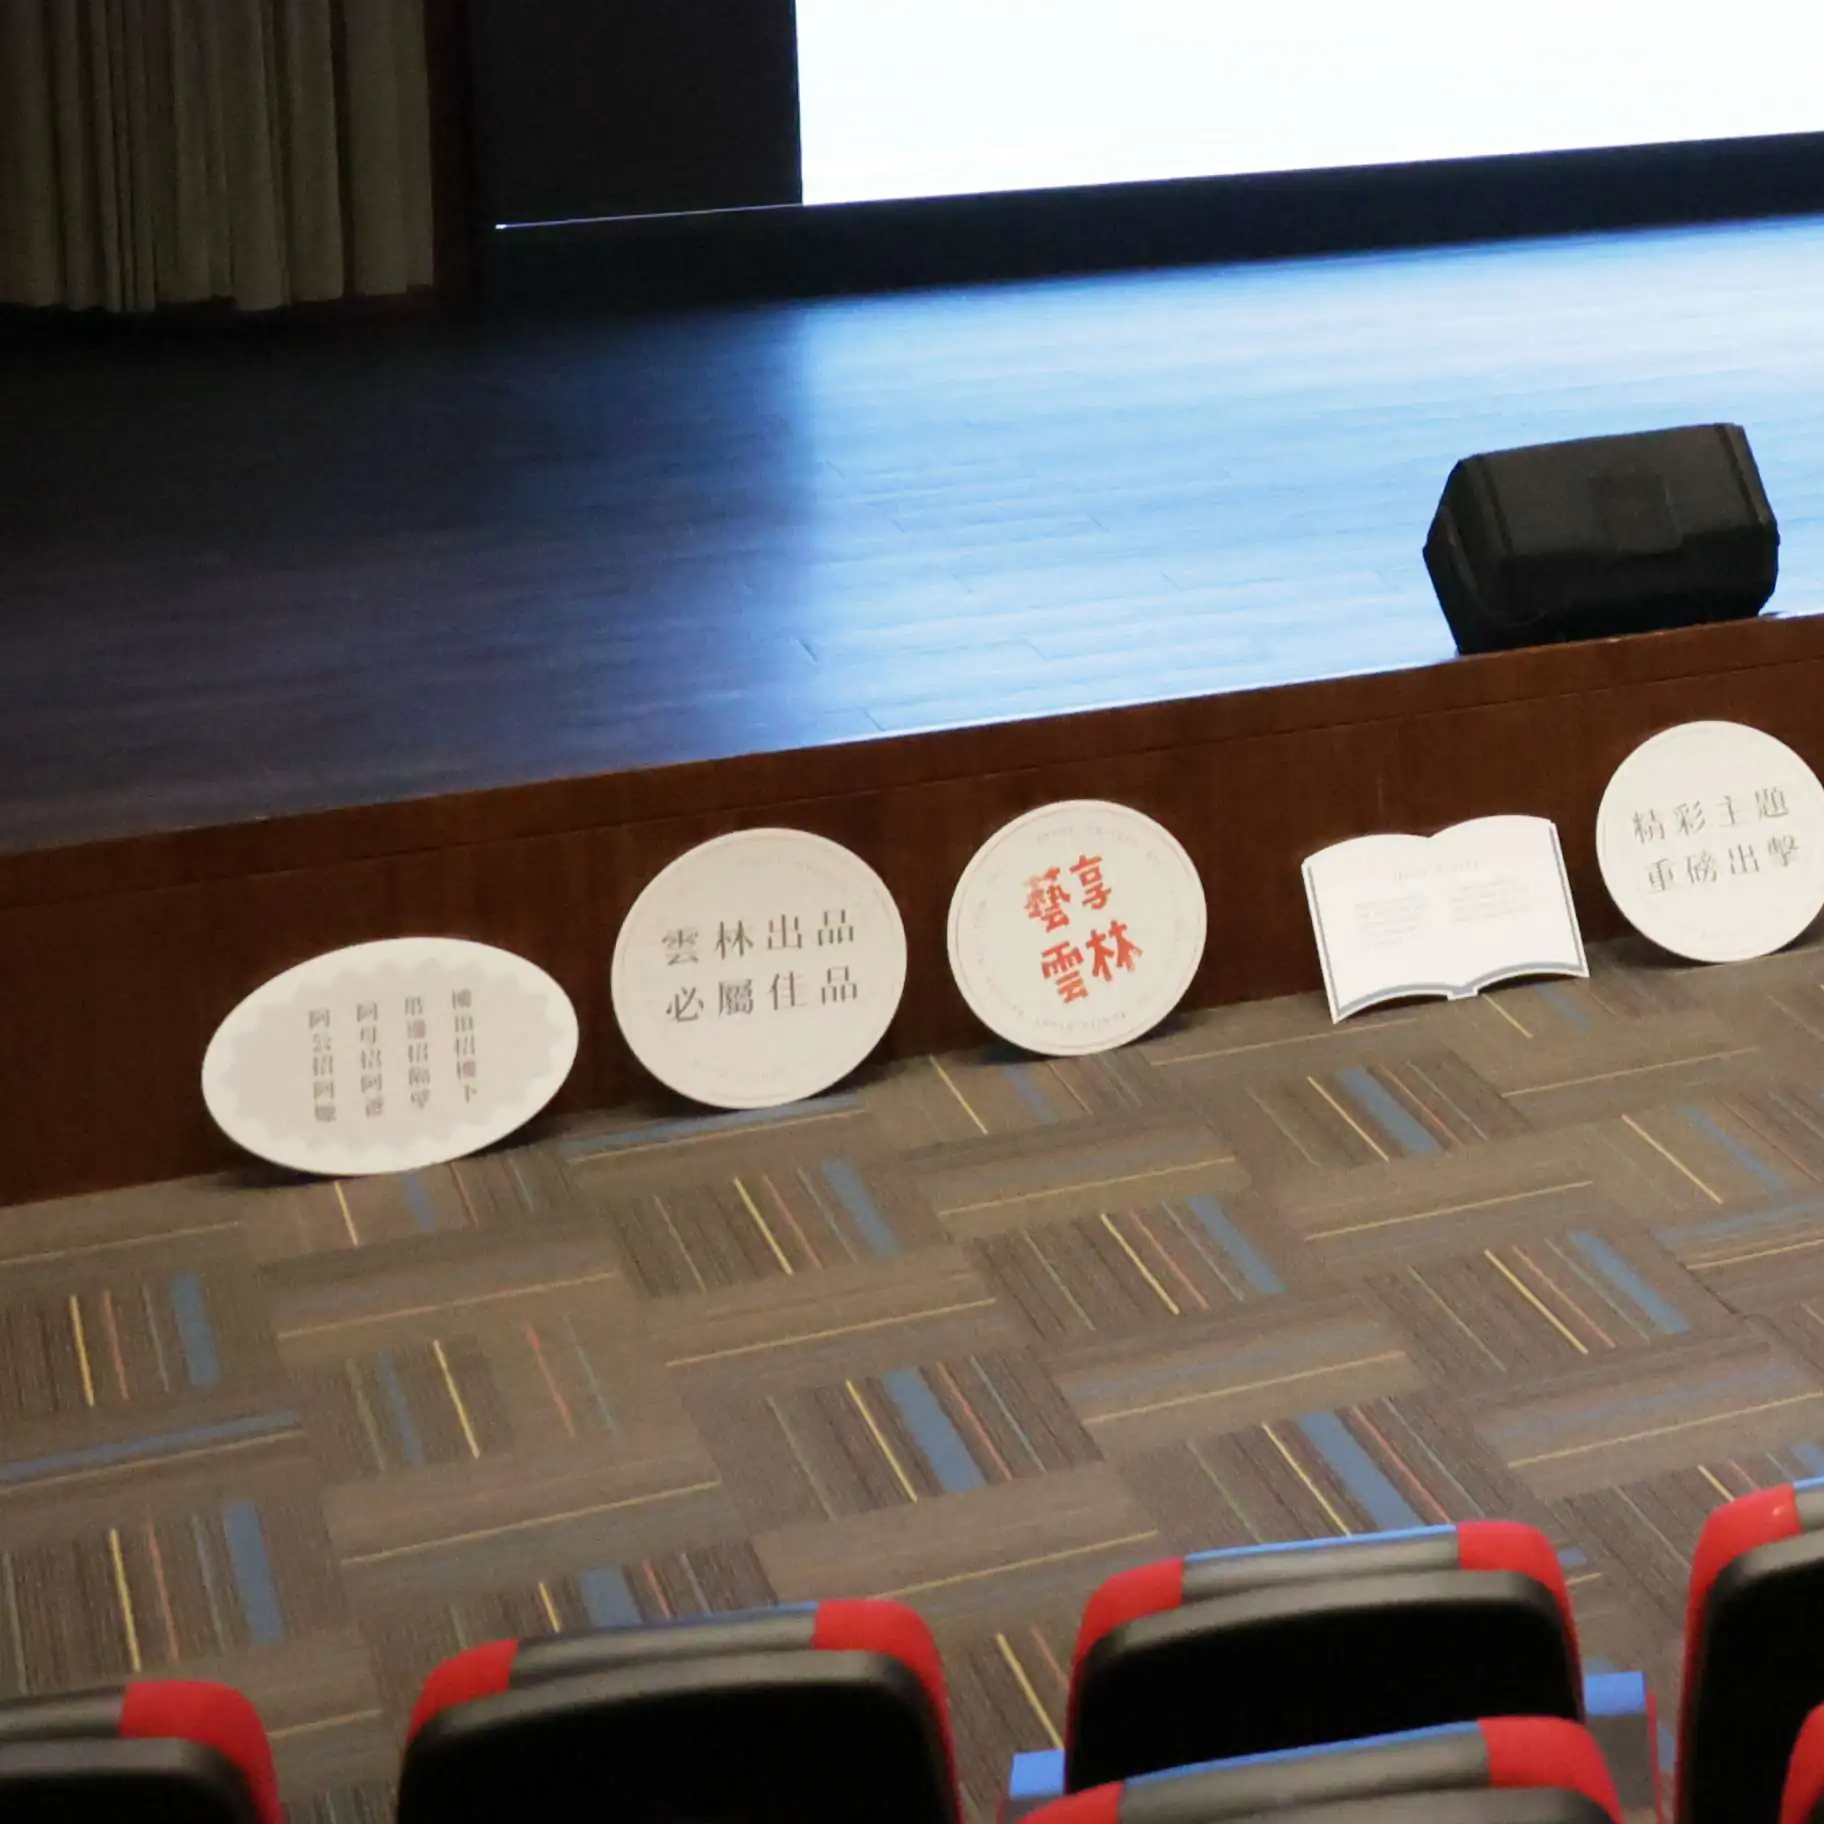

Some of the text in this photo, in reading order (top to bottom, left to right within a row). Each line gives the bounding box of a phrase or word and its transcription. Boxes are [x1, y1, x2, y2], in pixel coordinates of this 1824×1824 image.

[1630, 785, 1790, 845] 精彩主題
[1023, 854, 1112, 933] 藝享
[661, 908, 855, 967] 雲林出品
[1040, 919, 1144, 1005] 雲林
[665, 965, 858, 1024] 必屬佳品
